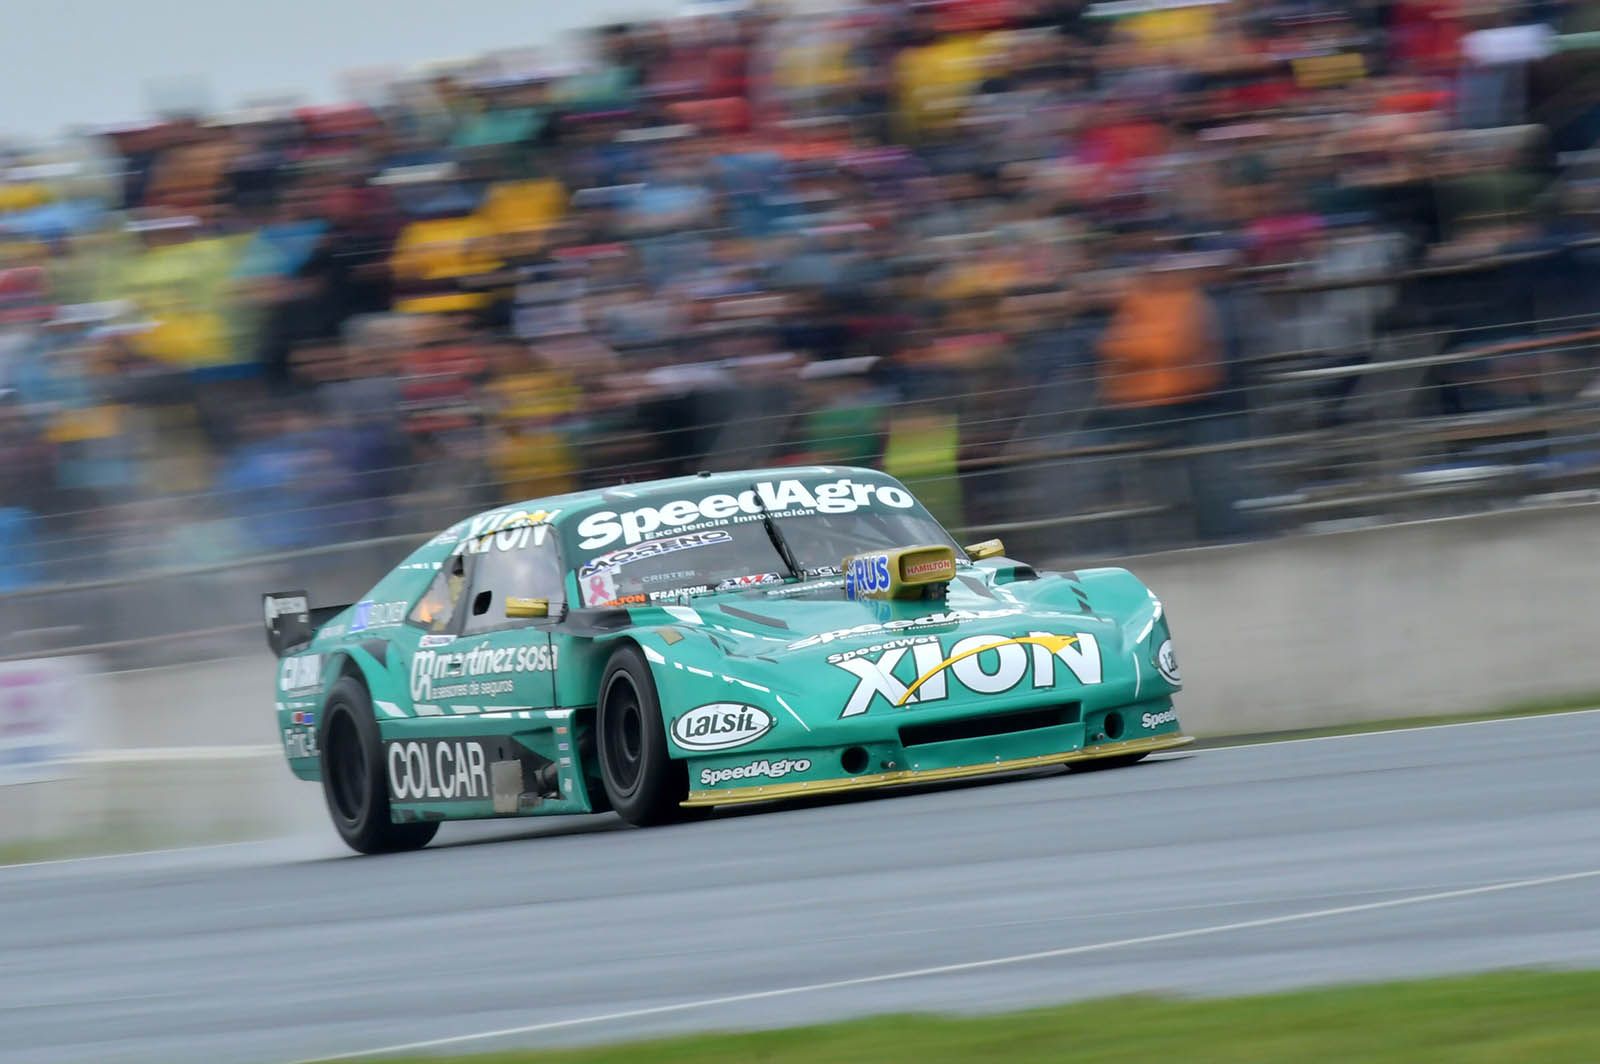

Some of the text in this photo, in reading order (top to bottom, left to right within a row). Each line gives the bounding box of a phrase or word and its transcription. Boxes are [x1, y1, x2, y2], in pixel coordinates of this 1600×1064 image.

[577, 479, 914, 550] SpeedAgro
[645, 519, 729, 540] Excelencia
[581, 530, 729, 578] MORENO
[906, 559, 952, 577] HAMILTON
[826, 635, 939, 665] SpeedWet
[839, 630, 1103, 720] XION
[387, 741, 489, 799] COLCAR
[700, 759, 812, 786] SpeedAgro
